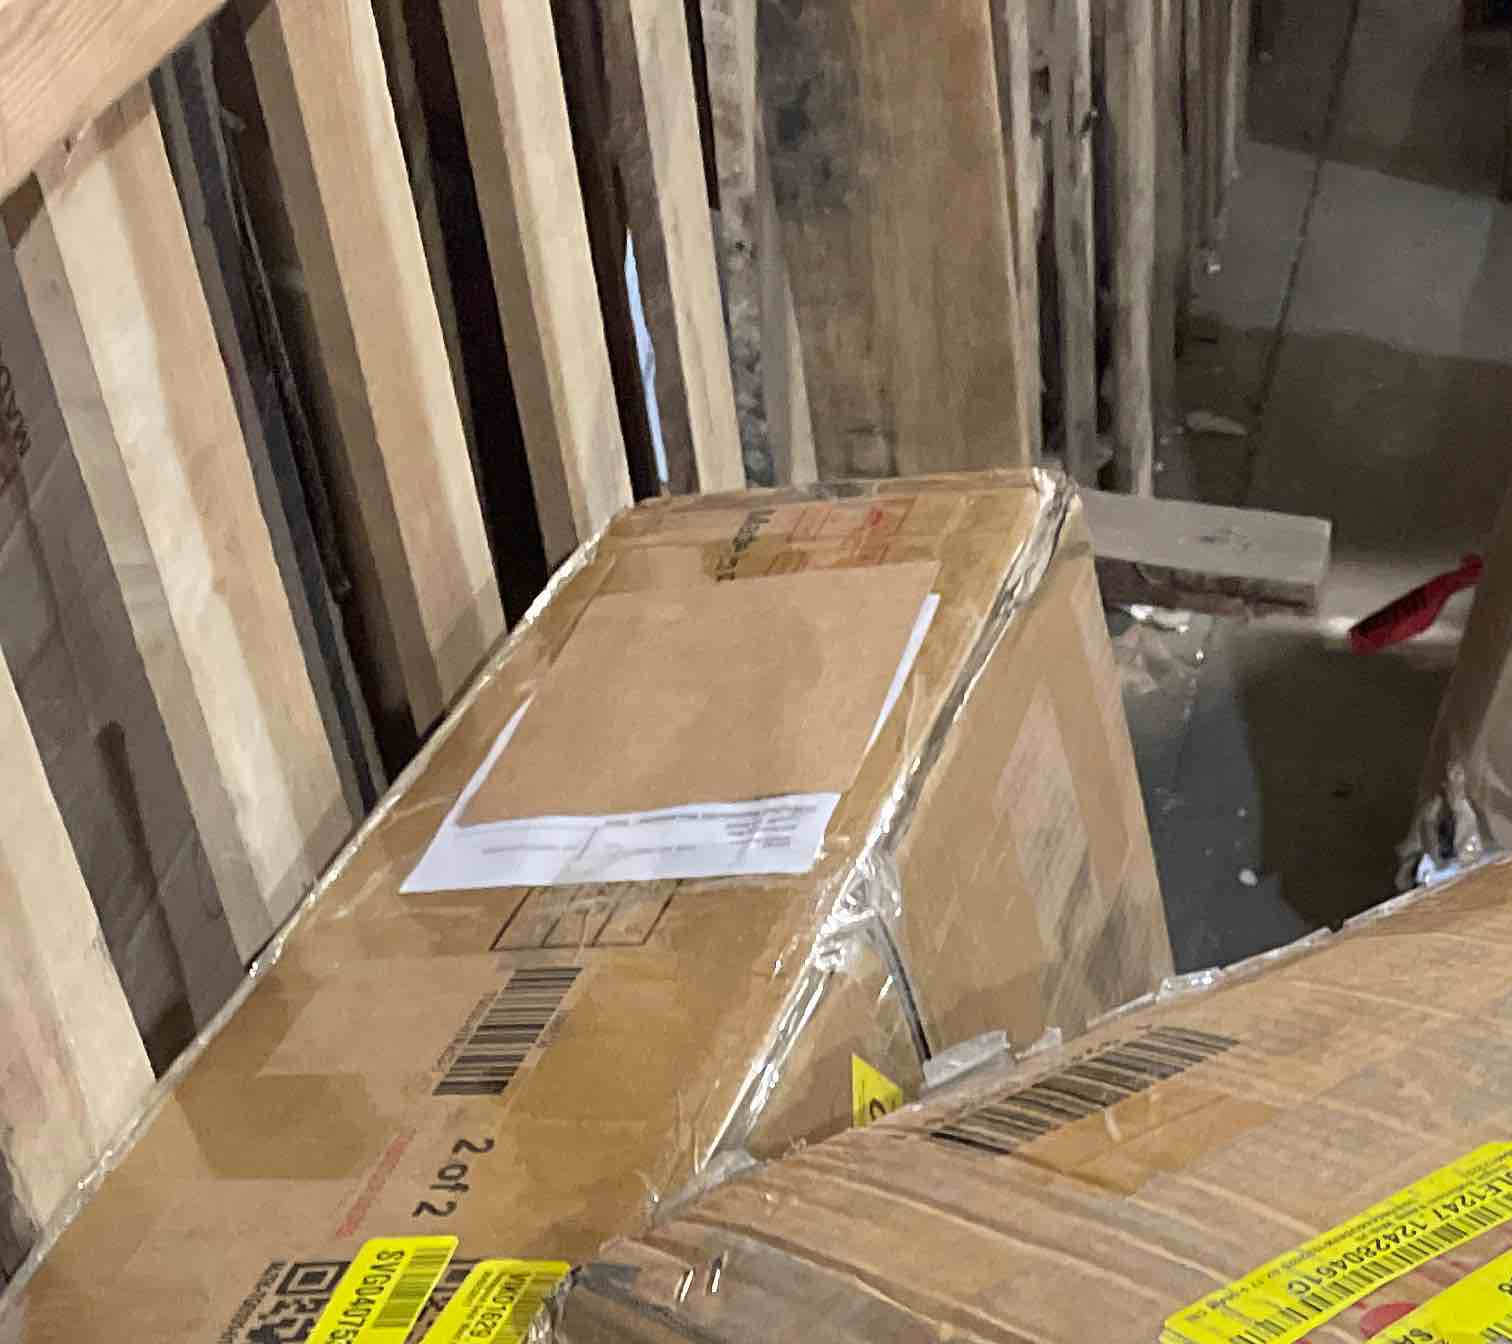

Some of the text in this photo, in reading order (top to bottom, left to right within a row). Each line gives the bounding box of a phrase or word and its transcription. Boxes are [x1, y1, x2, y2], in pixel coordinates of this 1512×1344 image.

[411, 1137, 495, 1218] 2 of 2
